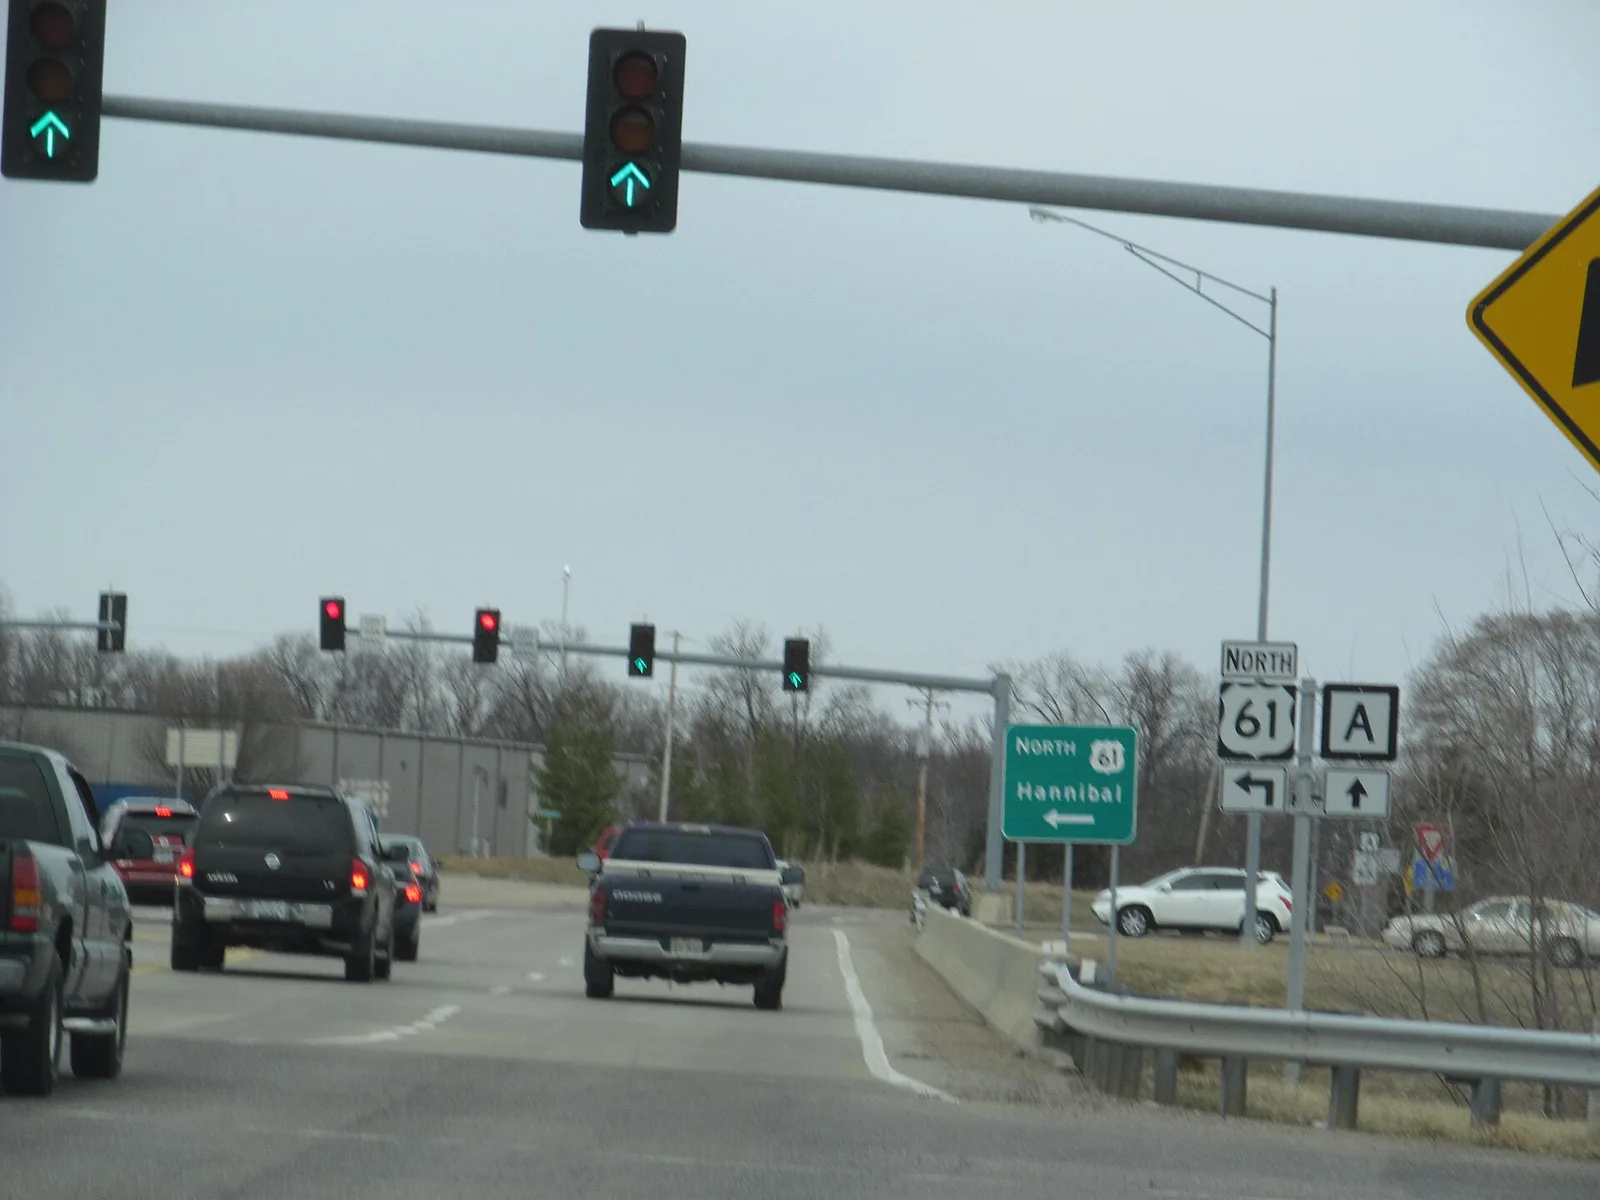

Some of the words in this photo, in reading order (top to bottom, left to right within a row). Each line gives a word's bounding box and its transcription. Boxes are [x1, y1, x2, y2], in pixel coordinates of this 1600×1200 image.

[1226, 647, 1293, 674] NORTH
[1234, 698, 1277, 739] 61
[1344, 702, 1375, 743] A
[1015, 736, 1077, 757] NORTH
[1097, 747, 1118, 768] 61
[1016, 781, 1122, 804] Hannibal
